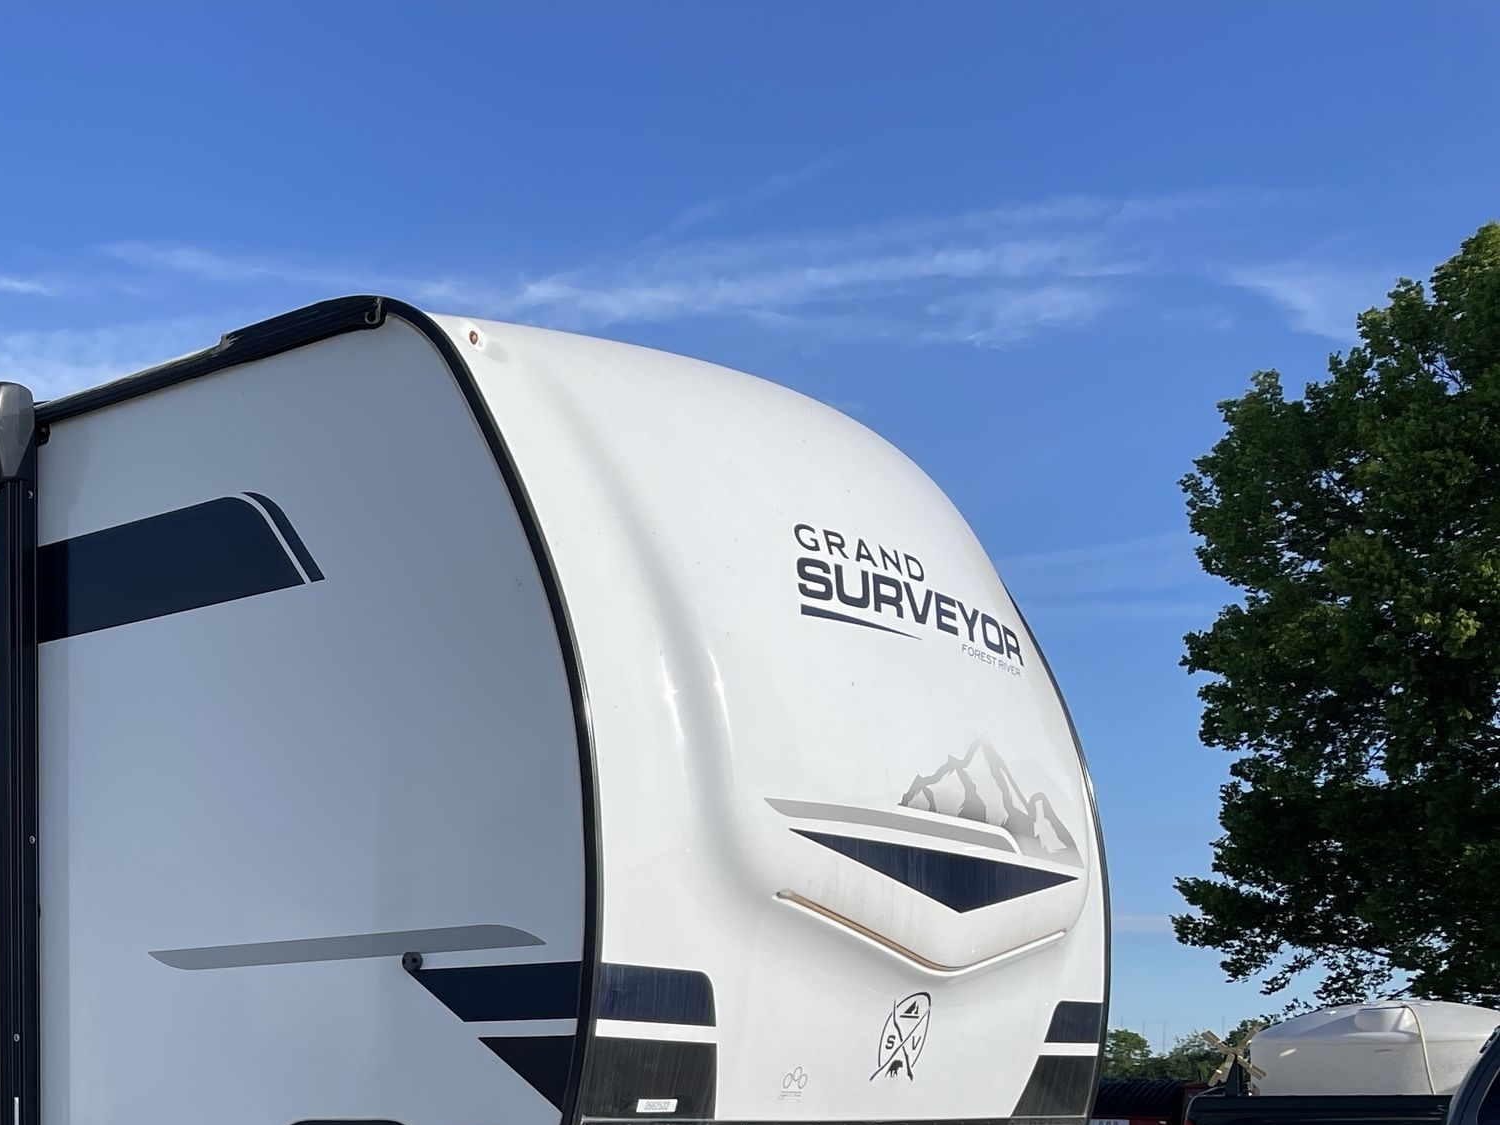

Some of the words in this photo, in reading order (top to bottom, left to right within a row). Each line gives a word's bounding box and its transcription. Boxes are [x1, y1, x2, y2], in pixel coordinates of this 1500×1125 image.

[794, 523, 925, 582] GRAND
[796, 556, 1024, 666] SURVEYOR
[961, 643, 997, 666] FOREST
[998, 660, 1021, 677] RIVER
[885, 1034, 896, 1050] S
[912, 1036, 921, 1050] V
